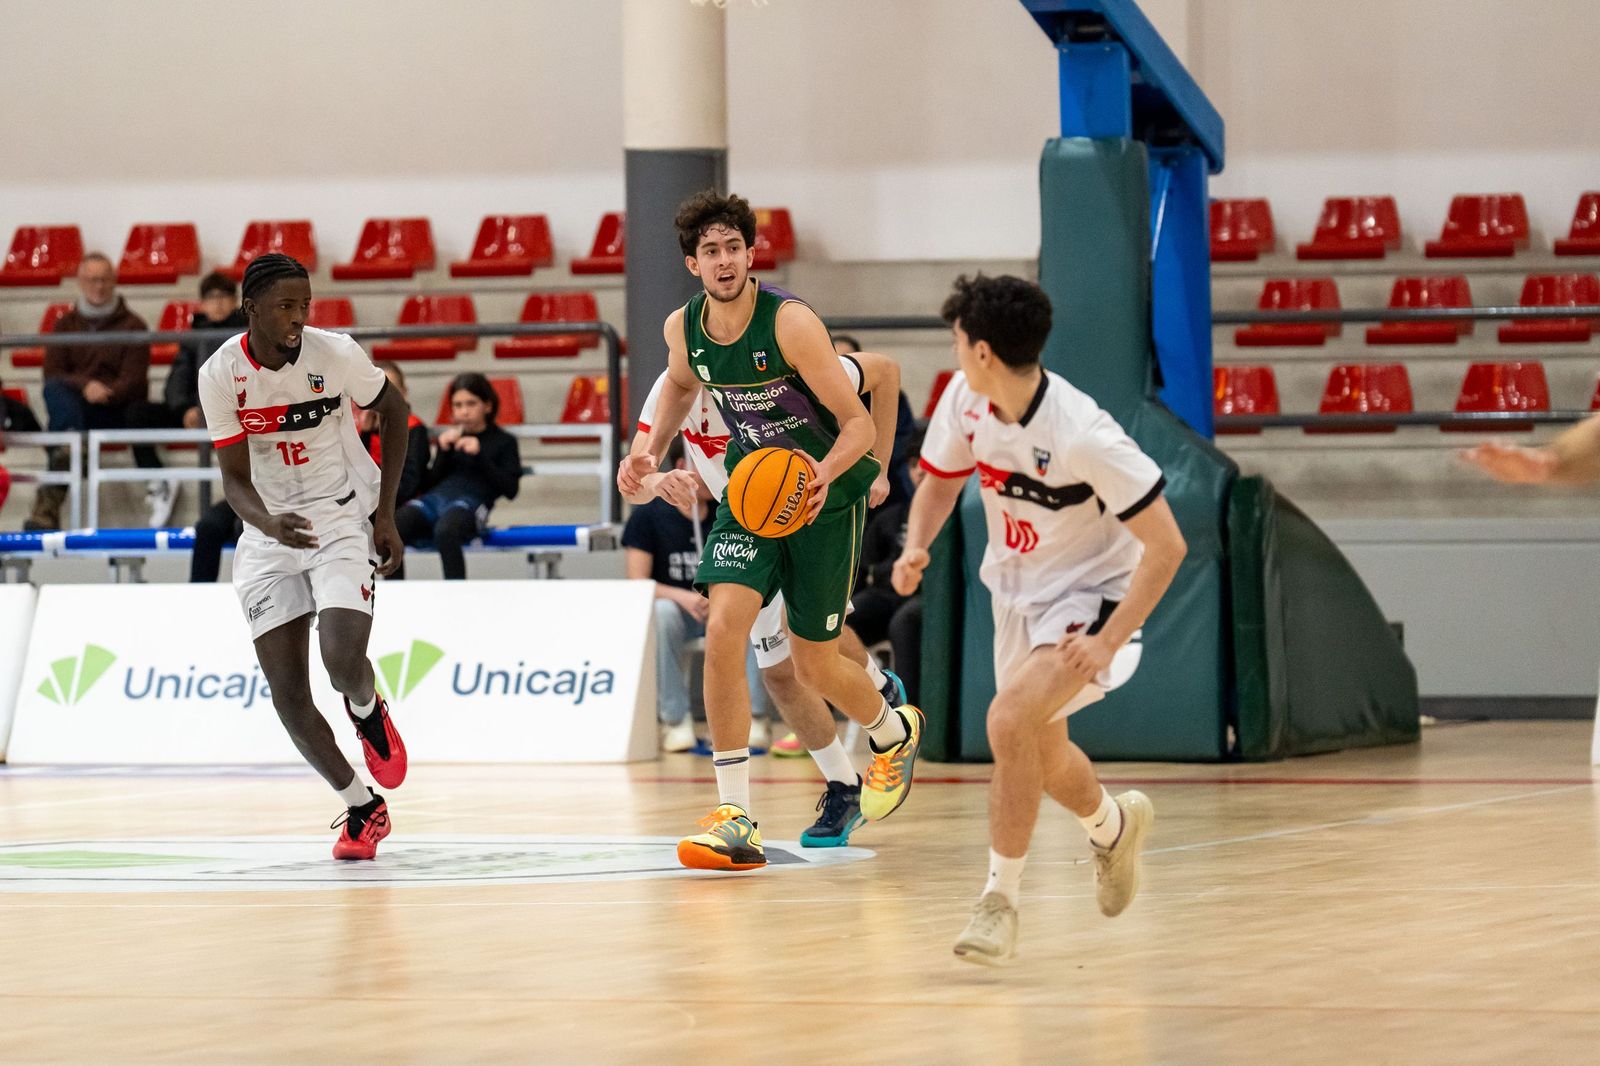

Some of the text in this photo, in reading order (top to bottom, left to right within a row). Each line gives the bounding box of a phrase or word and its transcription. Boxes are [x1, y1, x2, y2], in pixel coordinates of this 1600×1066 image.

[724, 384, 788, 402] Fundación
[276, 405, 330, 424] OPEL
[729, 400, 776, 412] Unicaja
[761, 415, 798, 431] Alhaurín
[764, 430, 776, 438] de
[785, 417, 809, 430] Torre
[276, 441, 310, 466] 12
[773, 470, 807, 527] Wilson
[720, 532, 755, 543] CLINICAS
[714, 560, 747, 570] DENTAL
[452, 660, 615, 706] Unicaja
